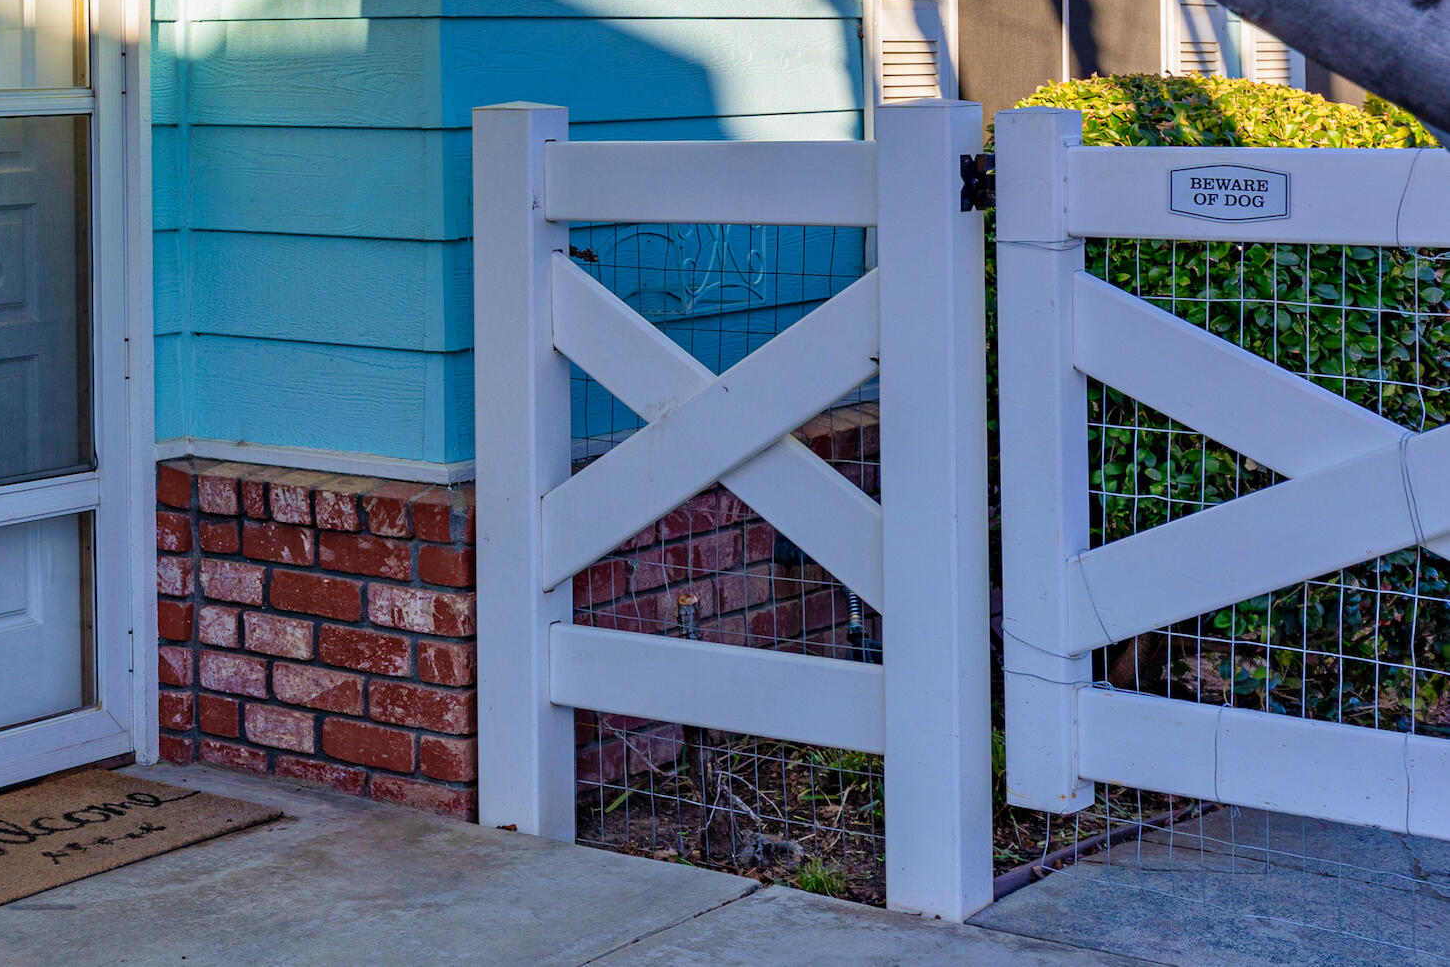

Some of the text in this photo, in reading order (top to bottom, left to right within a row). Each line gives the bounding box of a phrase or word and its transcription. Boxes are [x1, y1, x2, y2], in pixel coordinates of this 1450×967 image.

[1190, 177, 1269, 192] BEWARE
[1193, 192, 1265, 208] OF DOG
